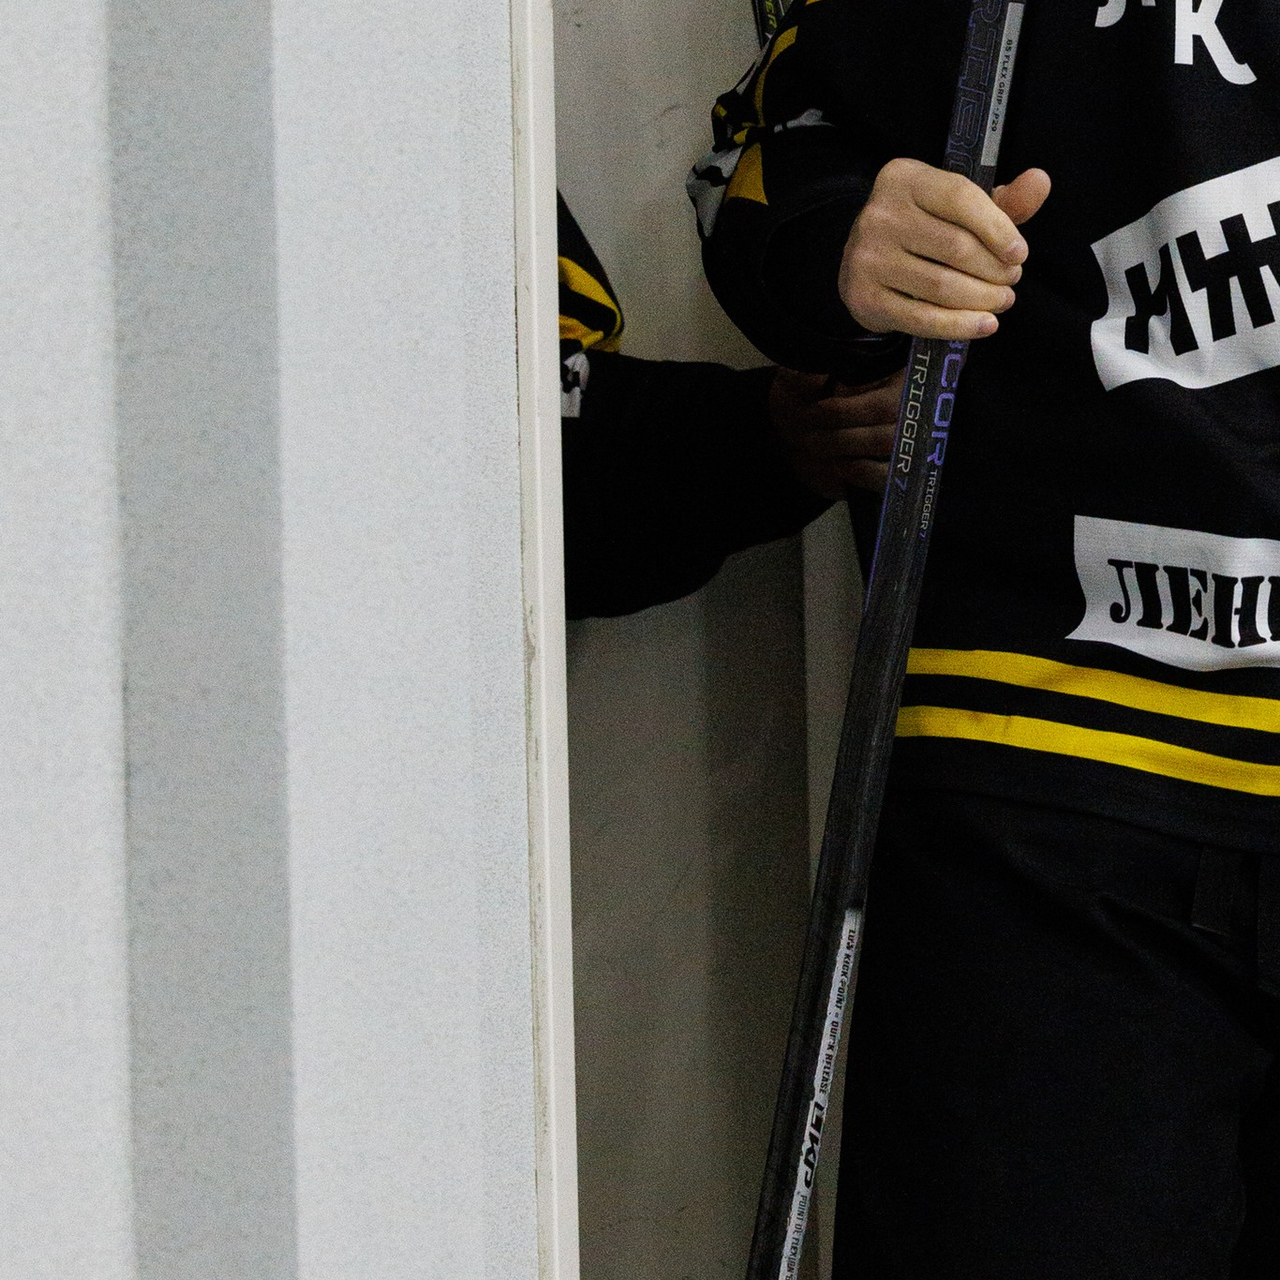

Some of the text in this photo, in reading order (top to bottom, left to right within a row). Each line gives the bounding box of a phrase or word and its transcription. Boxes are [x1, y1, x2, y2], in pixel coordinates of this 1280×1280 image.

[1000, 54, 1012, 80] FLEX
[996, 80, 1007, 105] GRIP
[897, 350, 931, 473] TRIGGER
[926, 341, 965, 467] COR
[921, 469, 938, 531] TRIGGER
[840, 952, 853, 978] KICK
